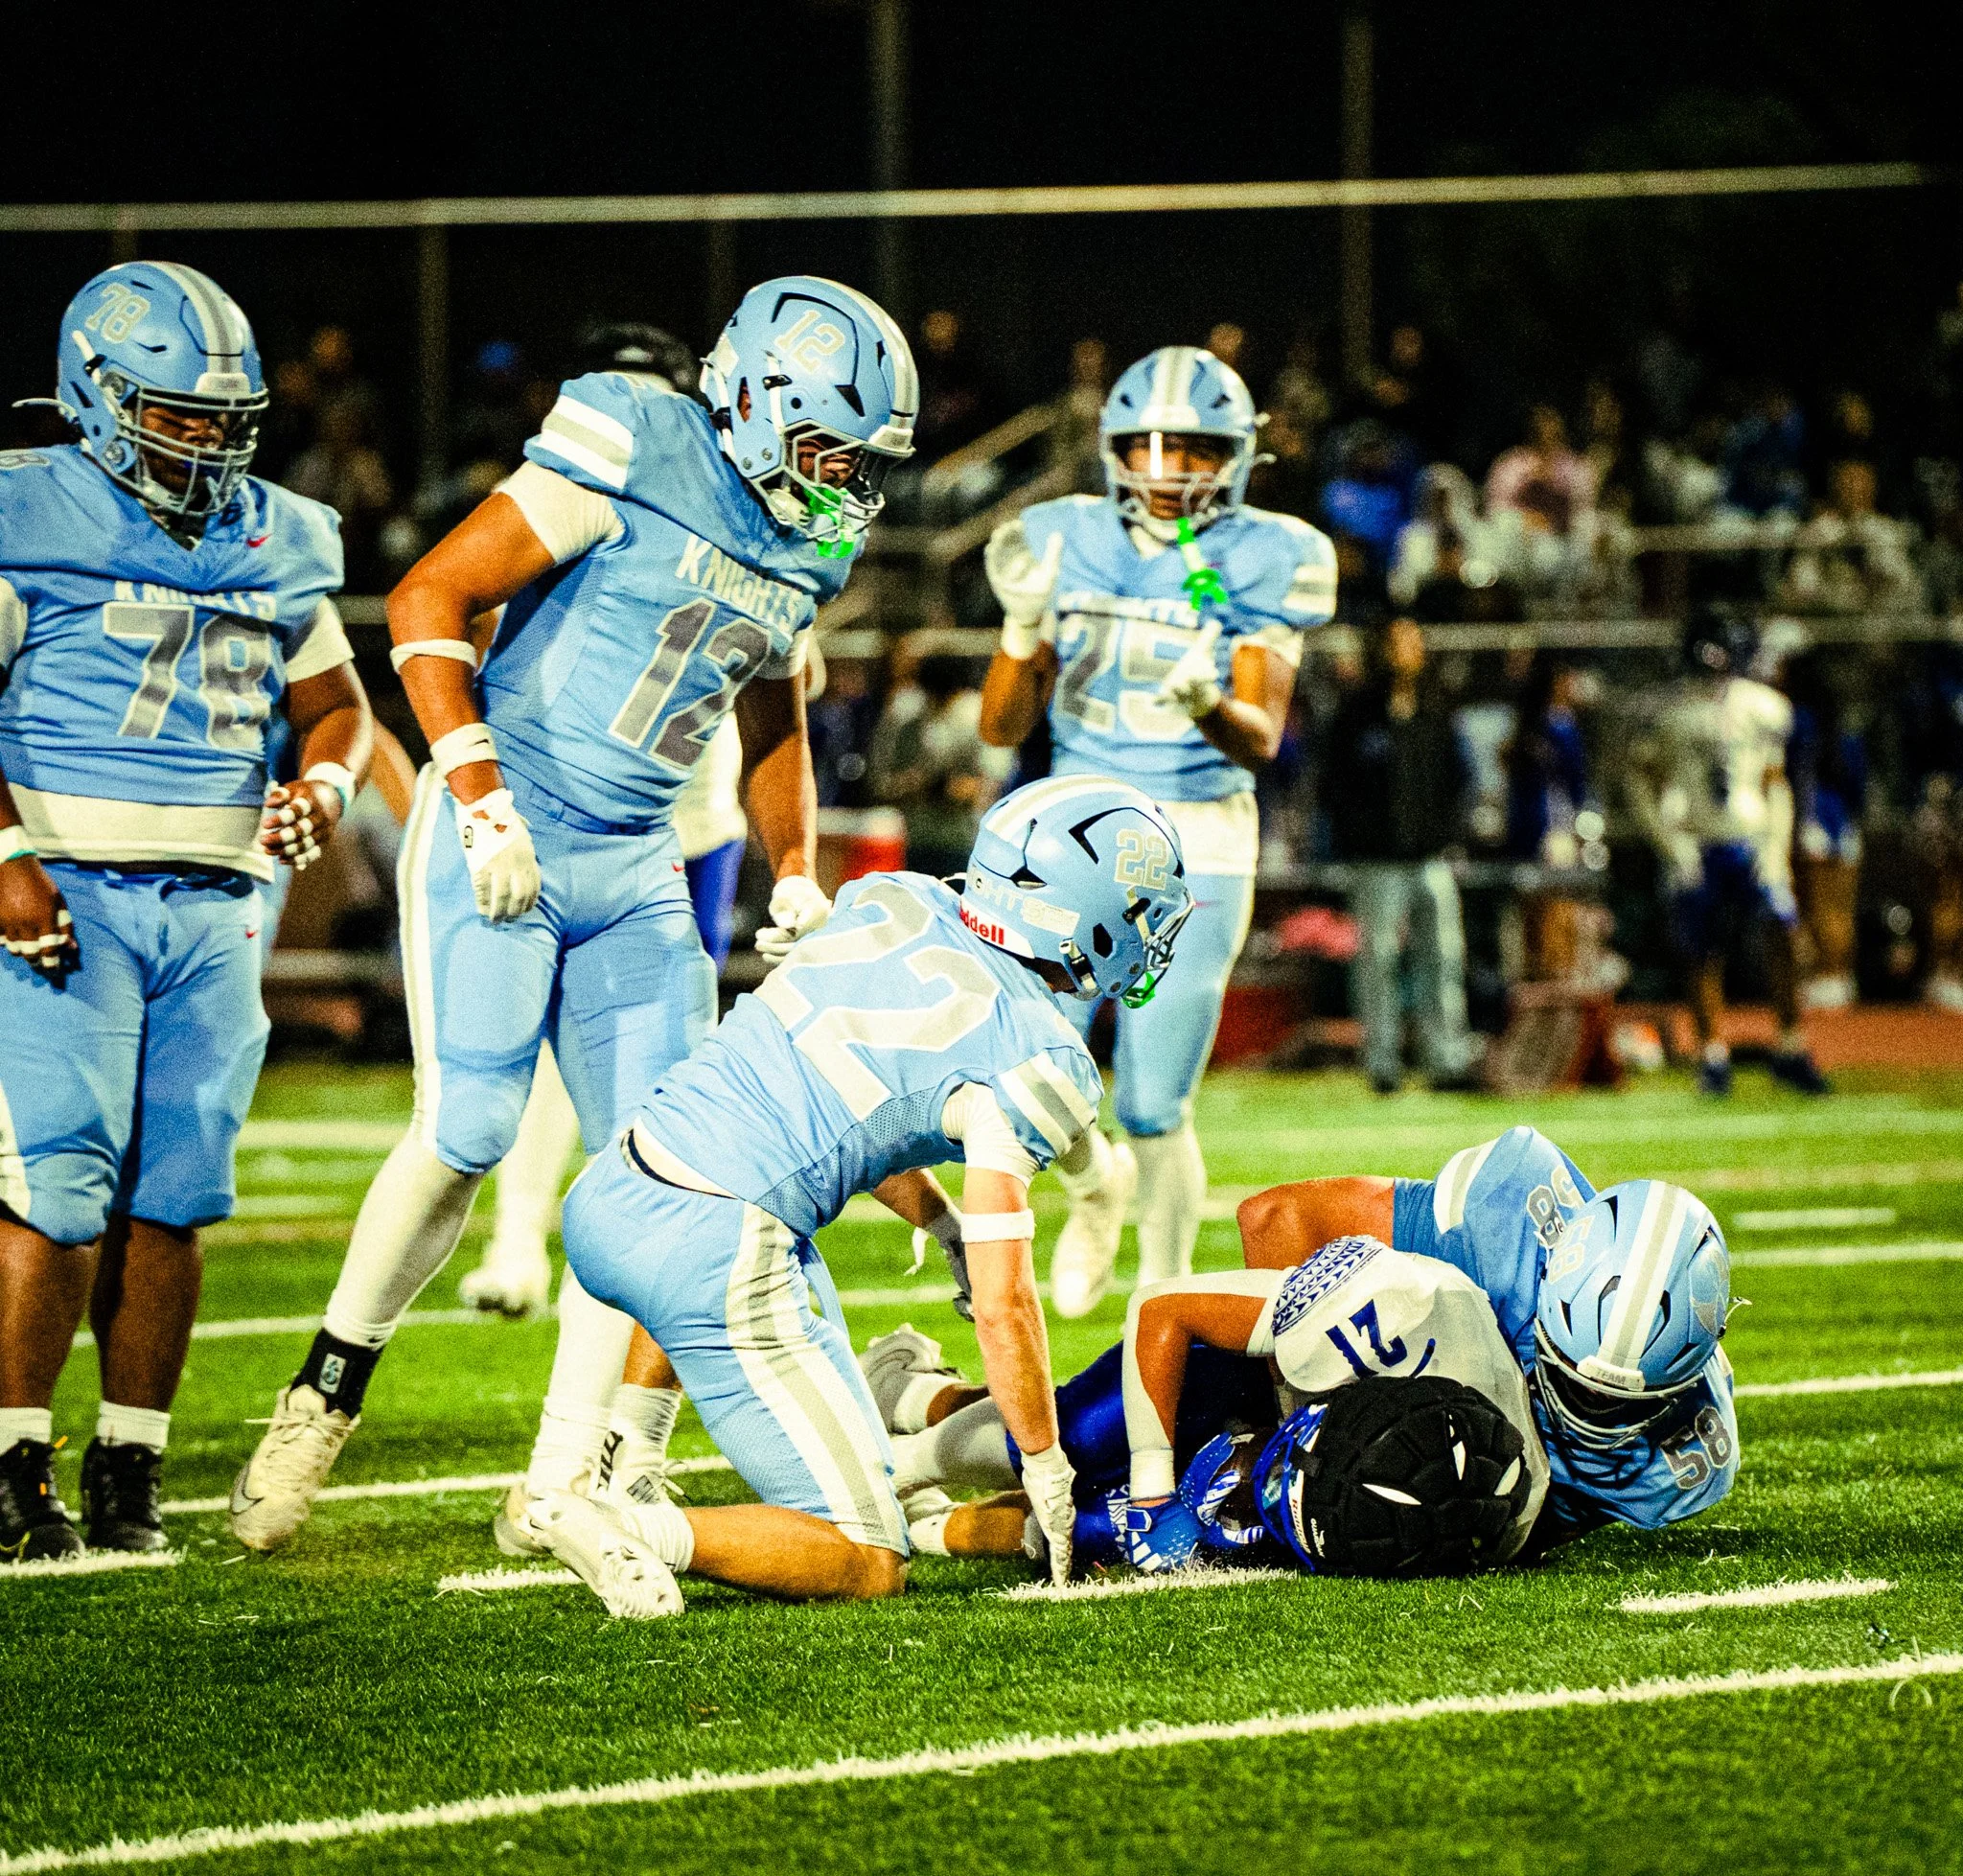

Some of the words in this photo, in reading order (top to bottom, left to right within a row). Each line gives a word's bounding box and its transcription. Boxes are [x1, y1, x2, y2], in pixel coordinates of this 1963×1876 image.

[84, 283, 151, 344] 78
[774, 309, 845, 375] 12
[675, 533, 804, 633] KNIGHTS
[103, 600, 272, 751] 78
[608, 597, 773, 769] 12
[1055, 614, 1200, 741] 25
[1114, 828, 1169, 891] 22
[959, 909, 1005, 945] ddell
[751, 881, 1003, 1123] 22
[1659, 1405, 1732, 1490] 58
